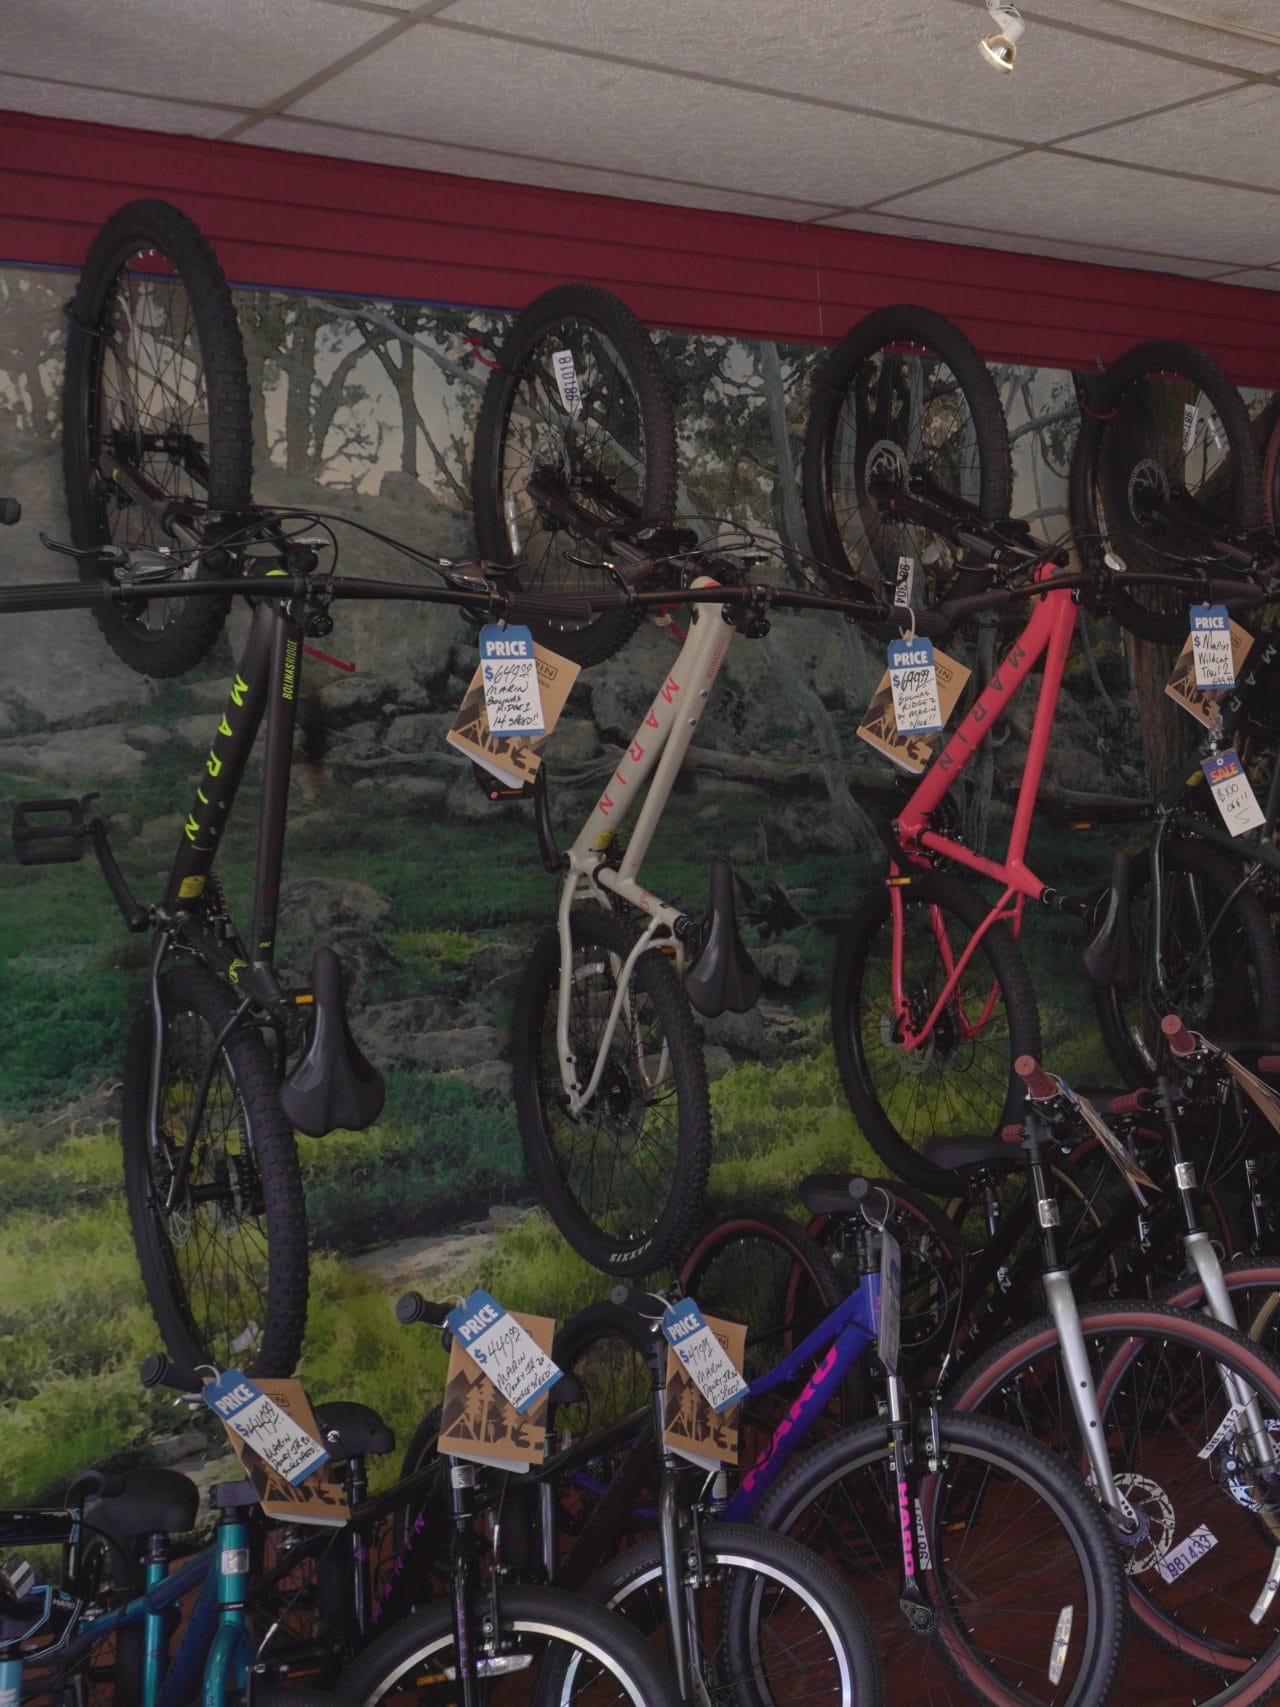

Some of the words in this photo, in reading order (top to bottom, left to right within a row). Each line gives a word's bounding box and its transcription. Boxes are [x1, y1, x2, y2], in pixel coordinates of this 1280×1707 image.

[896, 564, 910, 604] 98304
[1195, 617, 1225, 629] PRICE
[485, 640, 527, 656] PRICE
[893, 650, 928, 666] PRICE
[486, 682, 528, 696] MARIN
[1200, 643, 1278, 757] MARN
[939, 644, 1026, 772] MARIN
[185, 674, 249, 841] MARIN
[599, 676, 680, 815] MARIN
[1210, 761, 1239, 784] SALE
[458, 1304, 499, 1341] PRICE
[667, 1313, 700, 1340] PRICE
[497, 1352, 526, 1389] MARIN
[697, 1360, 723, 1384] MARIN
[214, 1383, 255, 1416] PRICE
[898, 1482, 915, 1576] HARO
[1167, 1534, 1211, 1577] 981433
